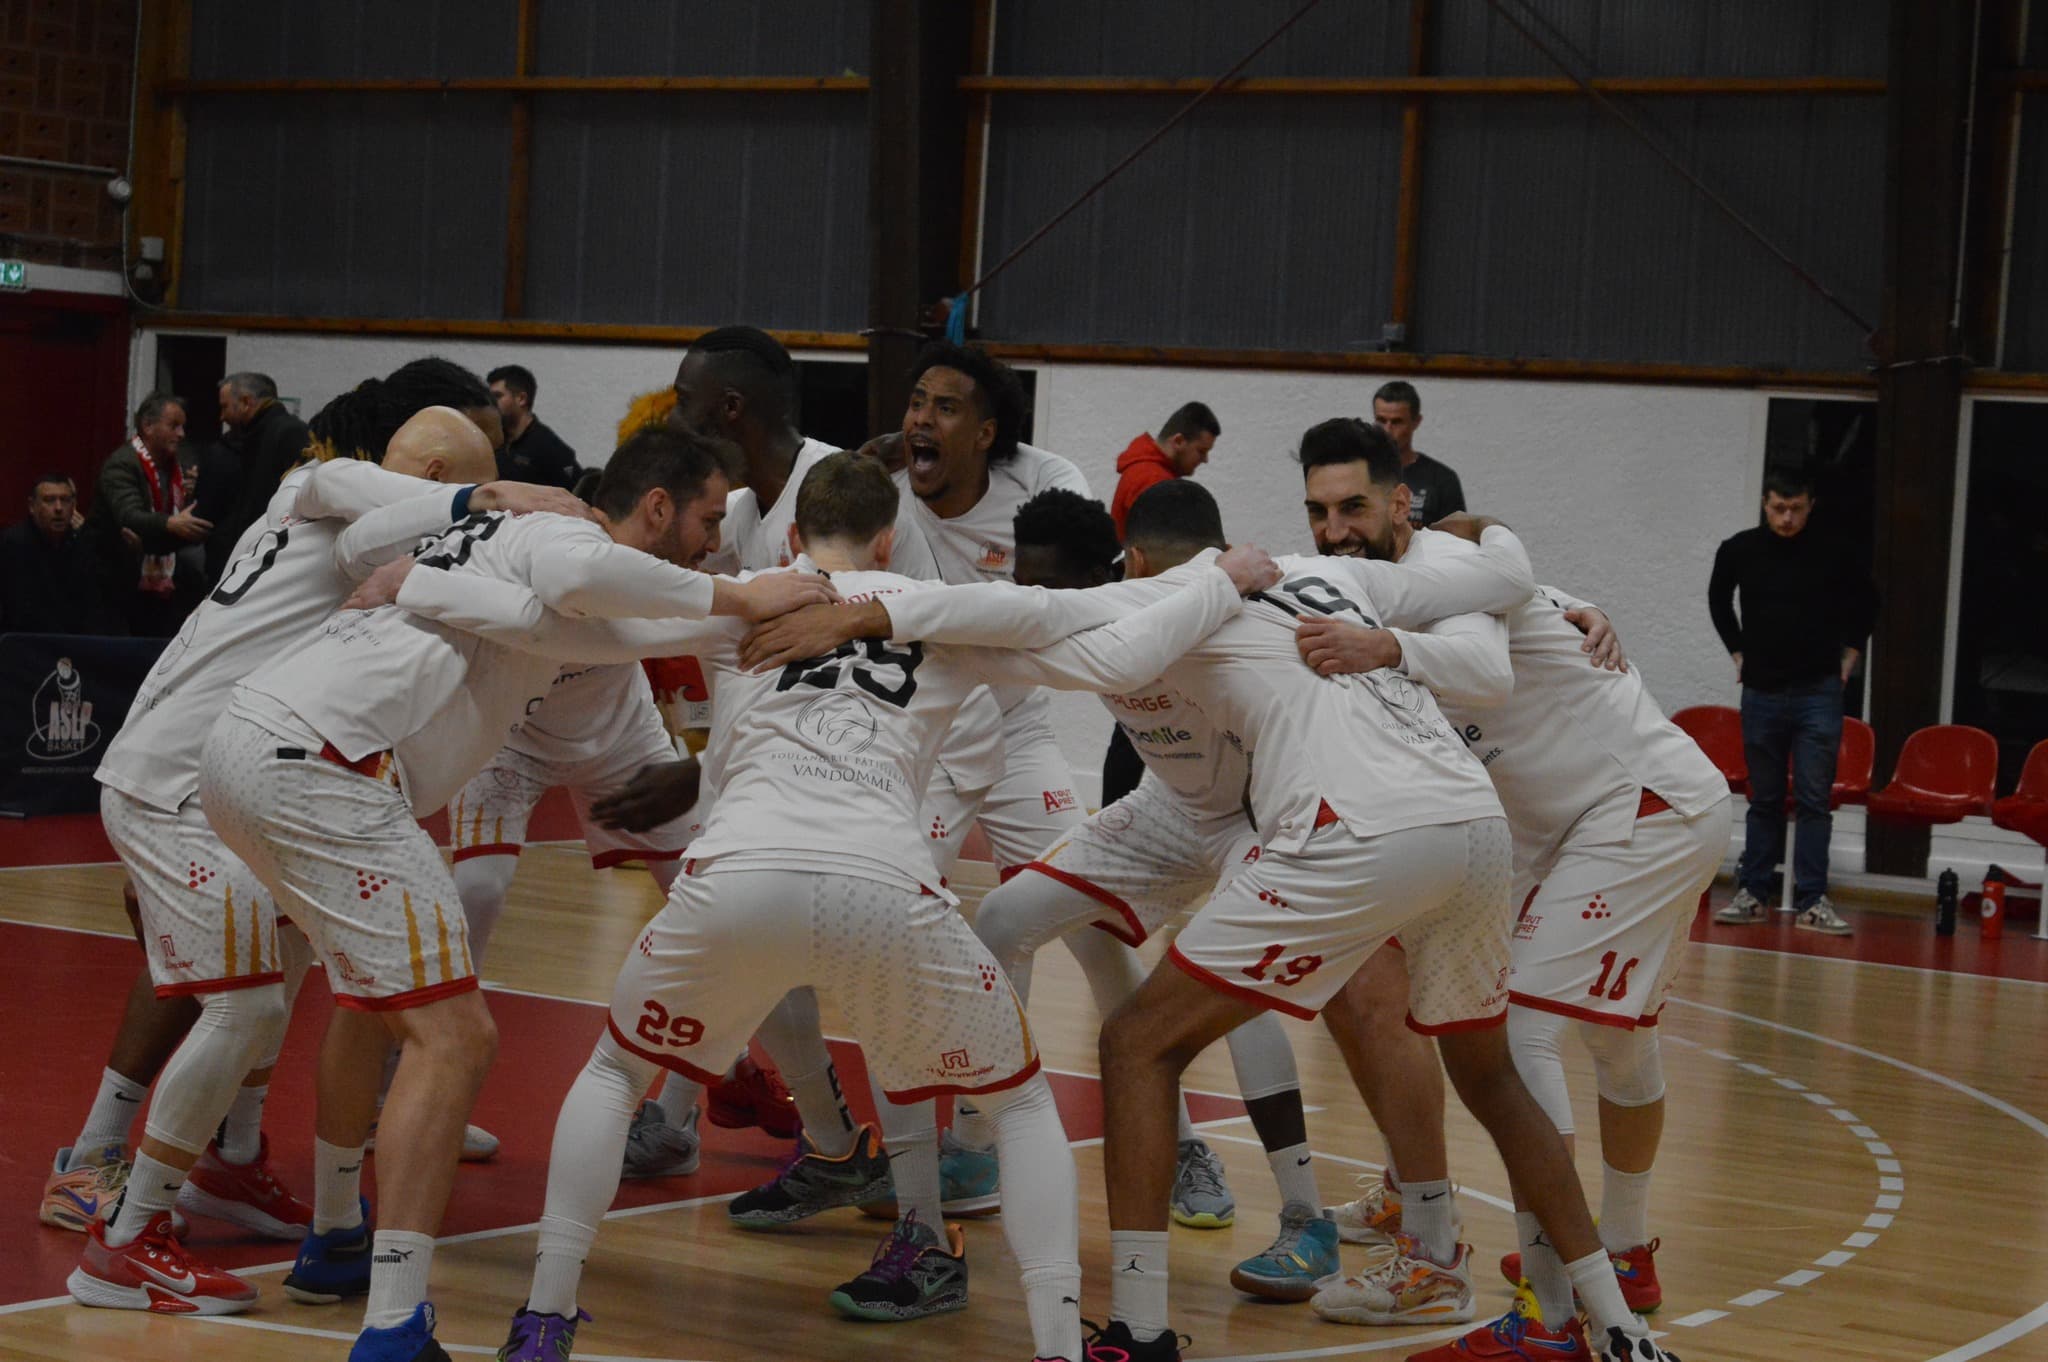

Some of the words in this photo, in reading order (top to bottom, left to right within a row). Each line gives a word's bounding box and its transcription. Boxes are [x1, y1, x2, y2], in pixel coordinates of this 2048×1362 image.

[793, 764, 893, 793] VANDOMME
[1241, 944, 1322, 986] 19
[1588, 951, 1639, 1000] 16
[636, 1000, 705, 1047] 29
